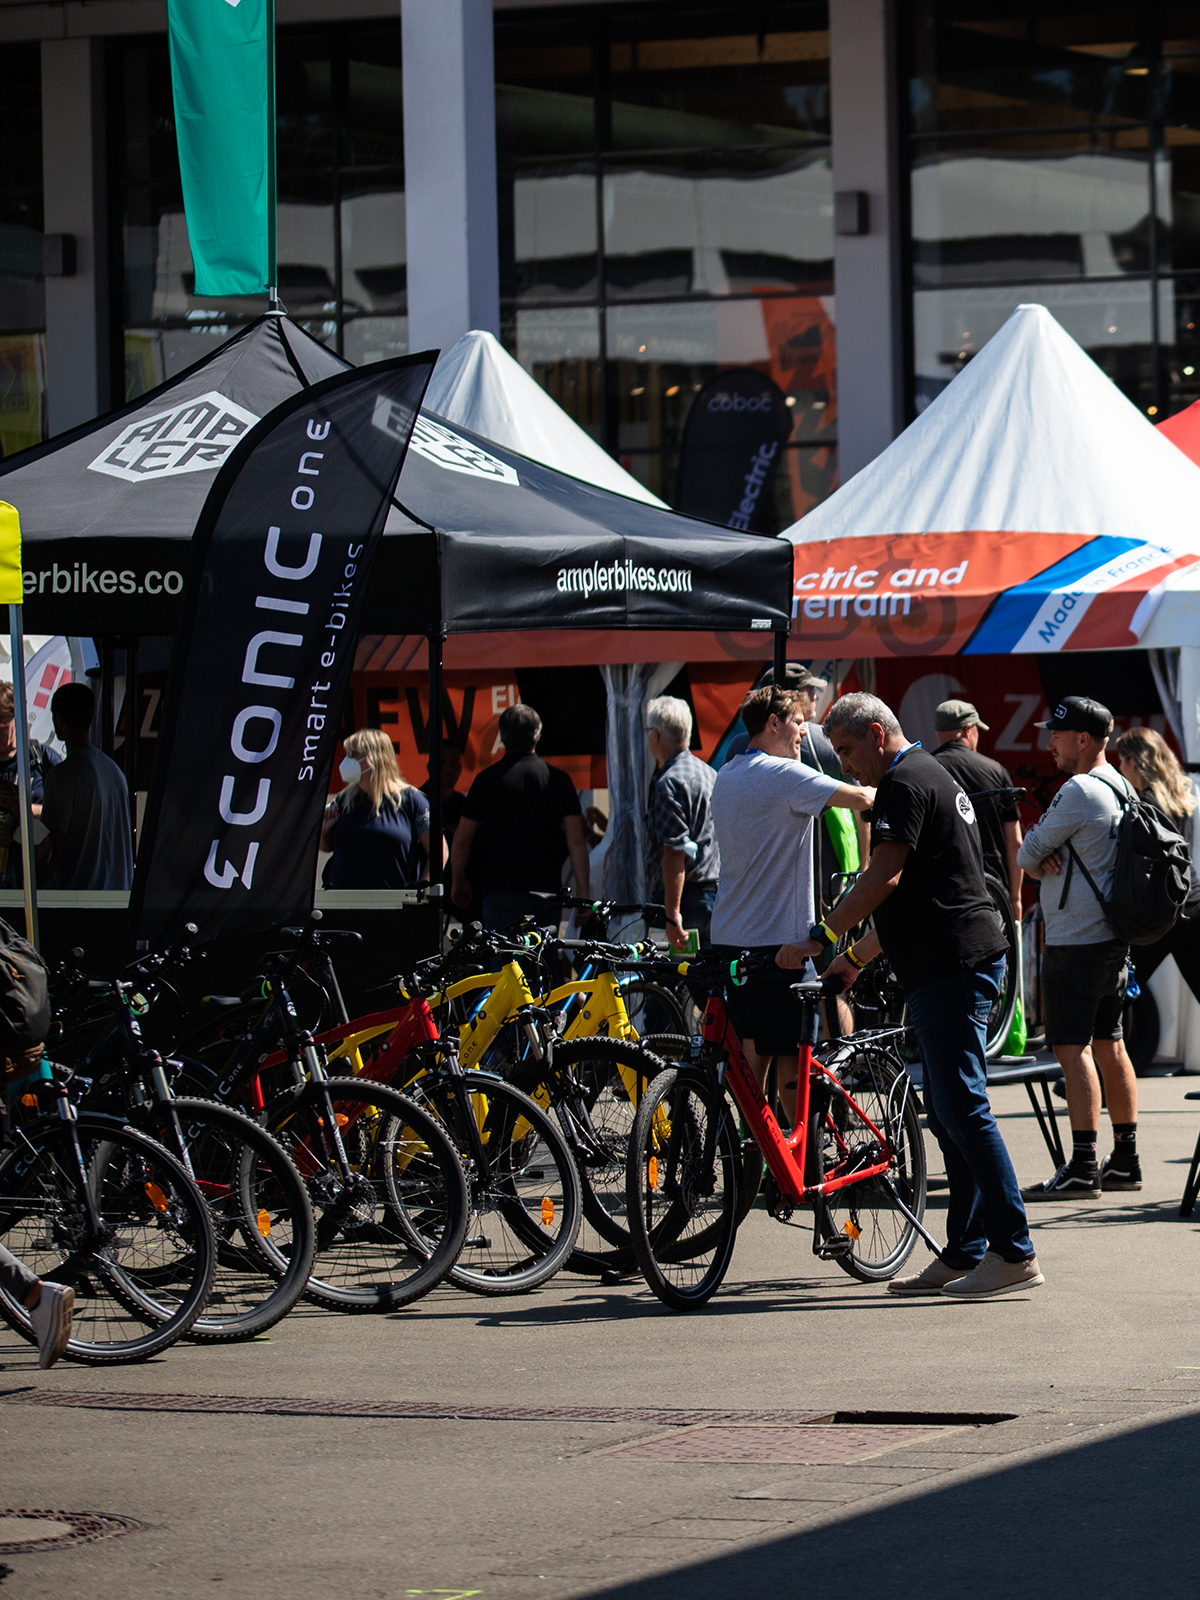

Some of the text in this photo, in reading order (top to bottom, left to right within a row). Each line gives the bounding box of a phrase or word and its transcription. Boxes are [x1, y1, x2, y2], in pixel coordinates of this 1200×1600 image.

[708, 391, 772, 412] coboc
[122, 400, 249, 445] AMP
[103, 440, 232, 474] LER
[22, 562, 185, 595] erbikes.co
[556, 558, 693, 599] amplerbikes.com
[793, 560, 970, 591] ctric and
[1037, 589, 1084, 644] Made
[1107, 544, 1173, 578] France
[297, 542, 364, 781] smart e-bikes
